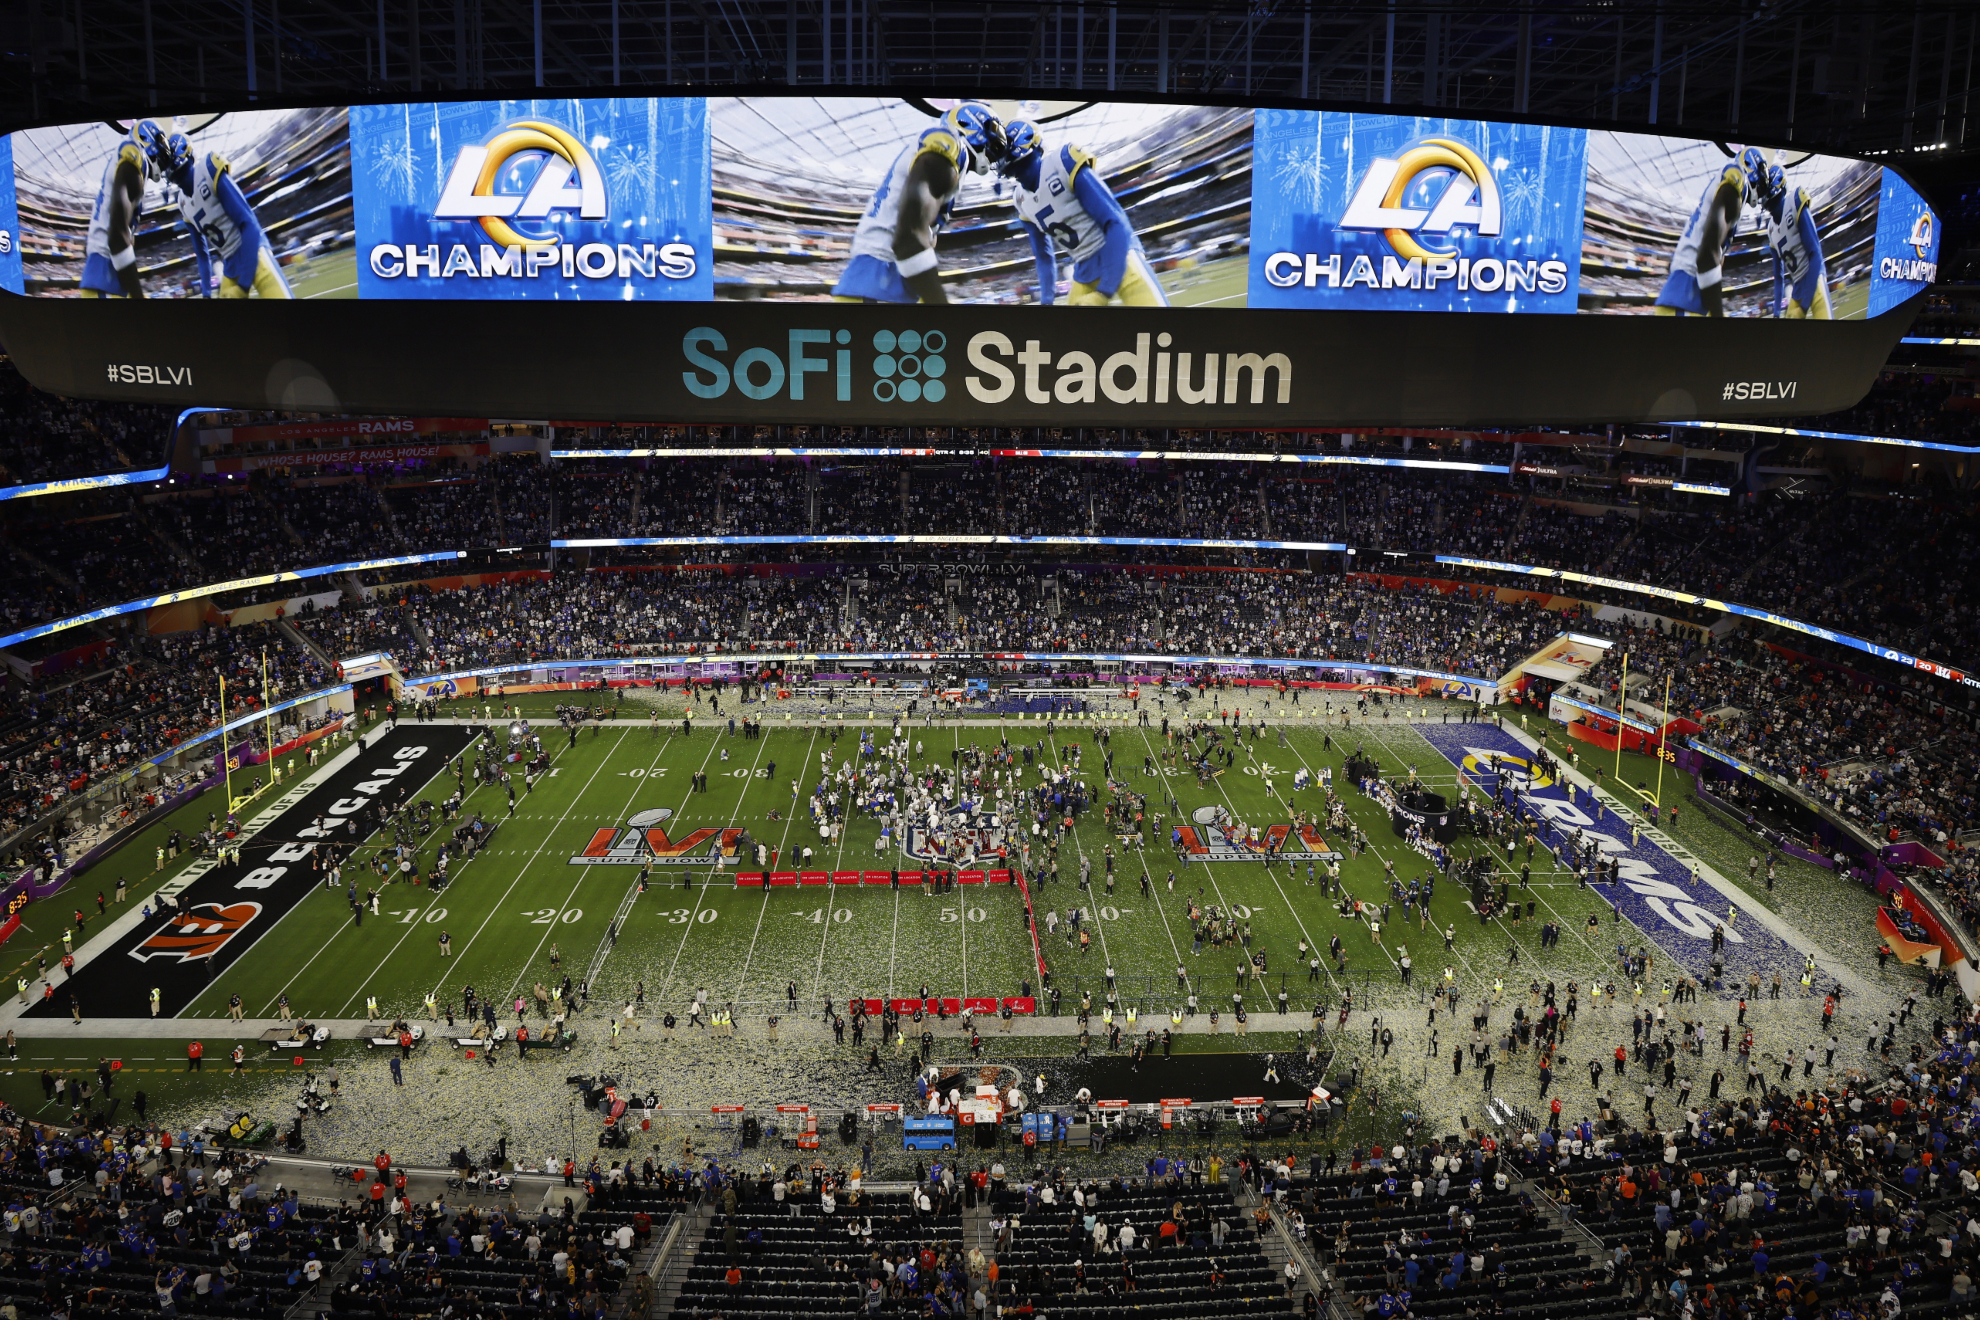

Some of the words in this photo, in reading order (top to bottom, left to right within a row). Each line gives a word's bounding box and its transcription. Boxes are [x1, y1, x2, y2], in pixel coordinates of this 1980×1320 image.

[369, 243, 698, 280] CHAMPIONS
[1263, 251, 1568, 295] CHAMPIONS
[107, 363, 193, 387] #SBLVI
[682, 326, 851, 402] SoFi
[965, 330, 1292, 405] Stadium
[1722, 381, 1798, 401] #SBLVI
[280, 427, 301, 435] LOS
[306, 424, 357, 434] ANGELES
[358, 420, 415, 434] RAMS
[257, 454, 304, 468] WHOSE
[306, 449, 357, 464] HOUSE?
[359, 449, 395, 461] RAMS
[396, 445, 440, 458] HOUSE!
[1900, 654, 1913, 665] 23
[1918, 662, 1932, 671] 20
[440, 672, 472, 682] SUPER
[471, 668, 499, 678] BOWL
[498, 666, 512, 674] LVI
[1388, 667, 1419, 677] SUPER
[1419, 670, 1443, 680] BOWL
[1443, 674, 1458, 682] LVI
[272, 798, 296, 812] OF
[290, 781, 318, 796] US
[1597, 796, 1632, 815] END
[233, 745, 428, 890] BENGALS
[1521, 794, 1745, 943] RAMS
[9, 890, 28, 915] 8:35
[395, 907, 449, 924] 10
[530, 908, 584, 925] 20
[668, 908, 719, 925] 30
[804, 908, 853, 924] 40
[939, 907, 988, 924] 50
[1913, 897, 1941, 928] CINCINNATI
[1939, 925, 1960, 953] BENGALS
[963, 1114, 973, 1124] G
